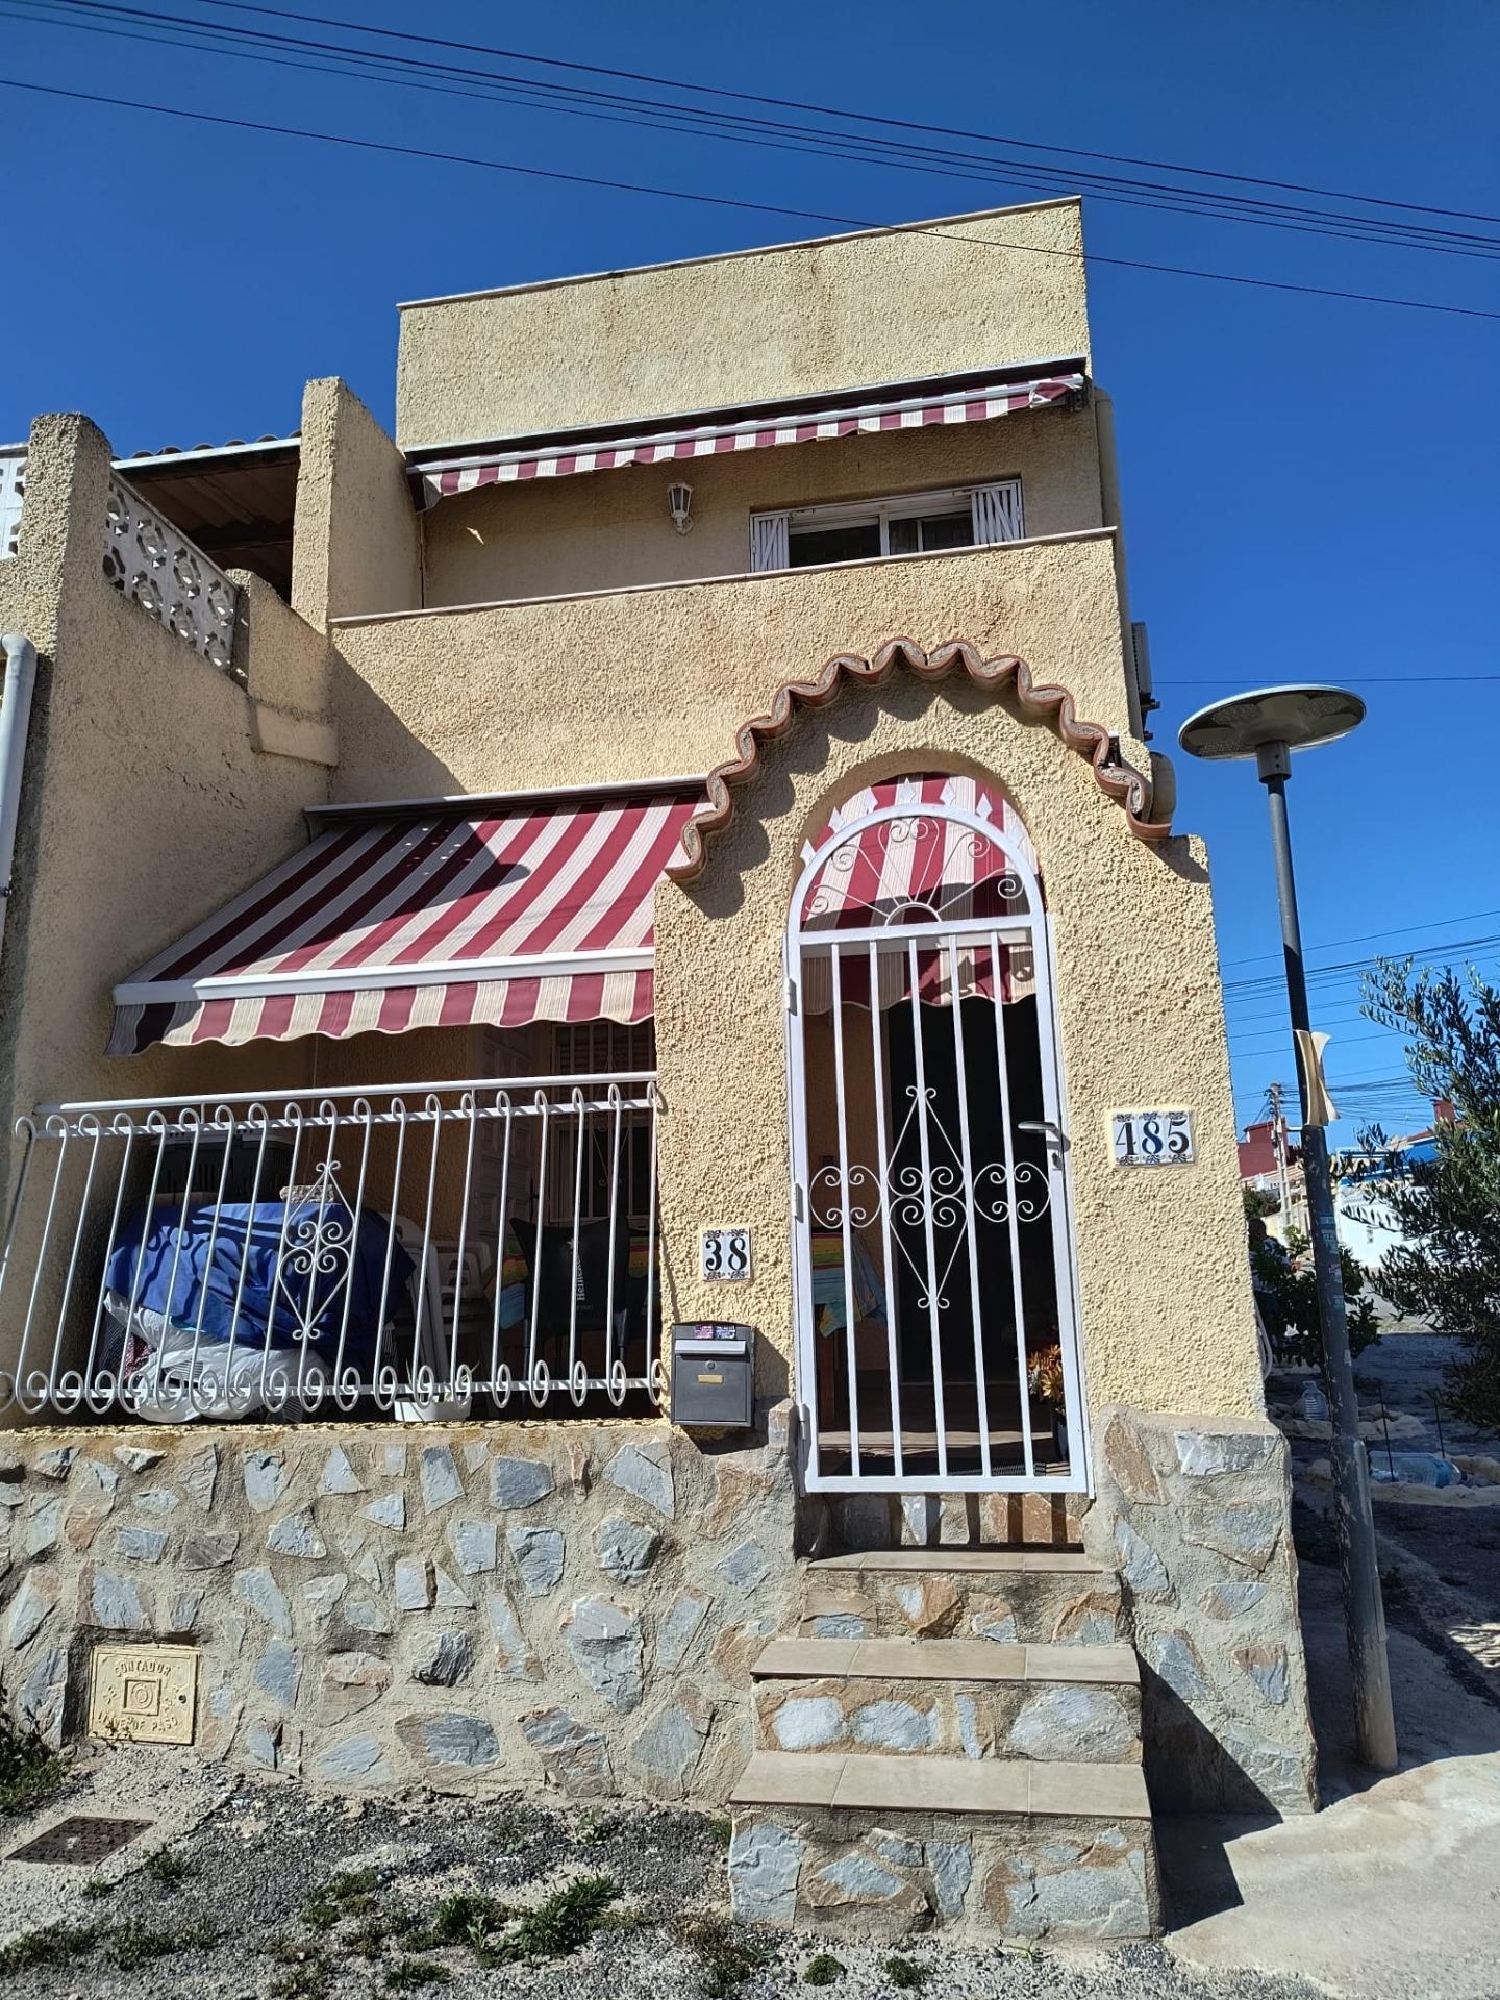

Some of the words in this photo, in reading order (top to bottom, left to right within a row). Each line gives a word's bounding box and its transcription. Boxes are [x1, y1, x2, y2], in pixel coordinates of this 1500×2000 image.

[1116, 1118, 1190, 1156] 485
[705, 1238, 748, 1272] 38
[115, 1659, 171, 1677] CONTADOR
